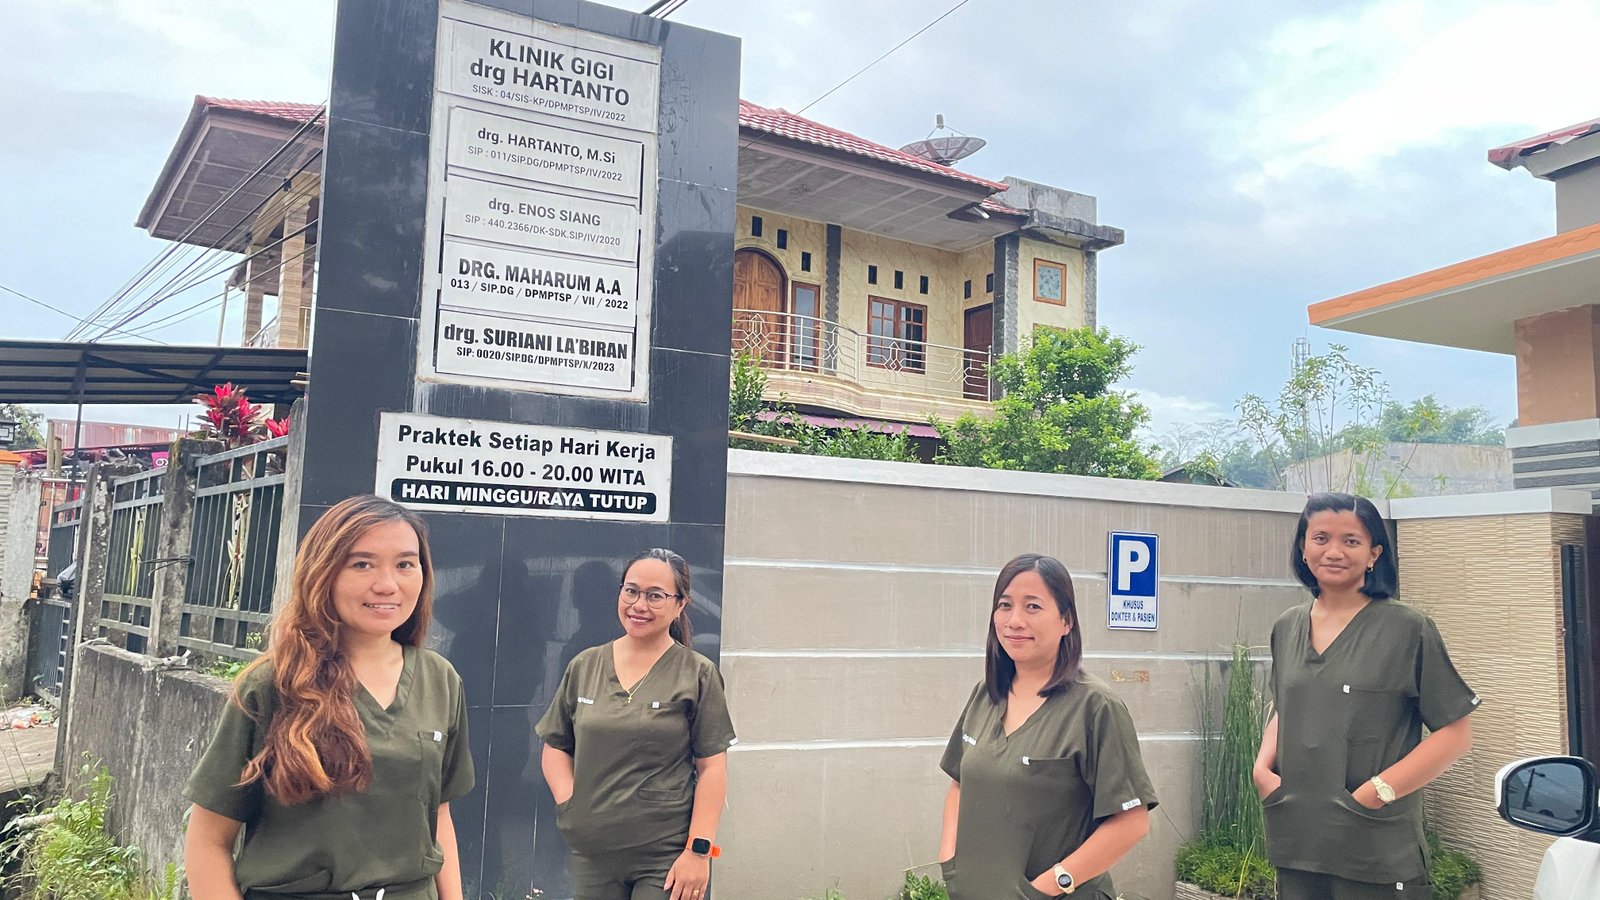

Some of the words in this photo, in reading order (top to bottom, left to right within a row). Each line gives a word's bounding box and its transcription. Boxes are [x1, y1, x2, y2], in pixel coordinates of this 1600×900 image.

[489, 38, 565, 71] KLINIK
[570, 56, 614, 81] GIGI
[470, 58, 506, 85] drg
[512, 66, 630, 106] HARTANTO
[472, 84, 494, 97] SISK
[500, 90, 626, 122] 04/SIS-KP/DPMPTSP/IV/2022
[468, 146, 484, 156] SIP
[490, 150, 623, 182] 011/SIP.DG/DPMPTSP/IV/2022
[477, 128, 504, 144] drg.
[507, 133, 583, 160] HARTANTO,
[586, 149, 616, 164] M.Si
[465, 214, 481, 224] SIP
[488, 219, 621, 246] 440.2366/DK-SDK.SIP/IV/2020
[488, 198, 515, 214] drg.
[518, 203, 556, 219] ENOS
[559, 210, 601, 226] SIANG
[450, 278, 470, 290] 013
[480, 283, 514, 296] SIP.DG
[525, 288, 572, 303] DPMPTSP
[582, 296, 596, 306] VII
[605, 298, 629, 310] 2022
[459, 258, 500, 280] DRG.
[505, 265, 591, 292] MAHARUM
[595, 278, 622, 295] A.A
[443, 324, 480, 344] drg.
[483, 327, 552, 351] SURIANI
[556, 337, 628, 360] LA'BIRAN
[456, 347, 475, 358] SIP:
[476, 348, 615, 372] 0020/SIP.DG/DPMPTSP/X/2023
[398, 424, 482, 448] Praktek
[488, 432, 553, 456] Setiap
[560, 437, 600, 456] Hari
[606, 441, 656, 463] Kerja
[406, 455, 463, 475] Pukul
[470, 460, 524, 478] 16.00
[542, 463, 594, 482] 20.00
[599, 467, 646, 486] WITA
[401, 483, 450, 500] HARI
[455, 486, 585, 507] MINGGU/RAYA
[589, 493, 648, 510] TUTUP
[1118, 539, 1150, 591] P
[1111, 611, 1132, 622] DOKTER
[1137, 612, 1155, 623] PASIEN
[1123, 600, 1144, 610] KHUSUS
